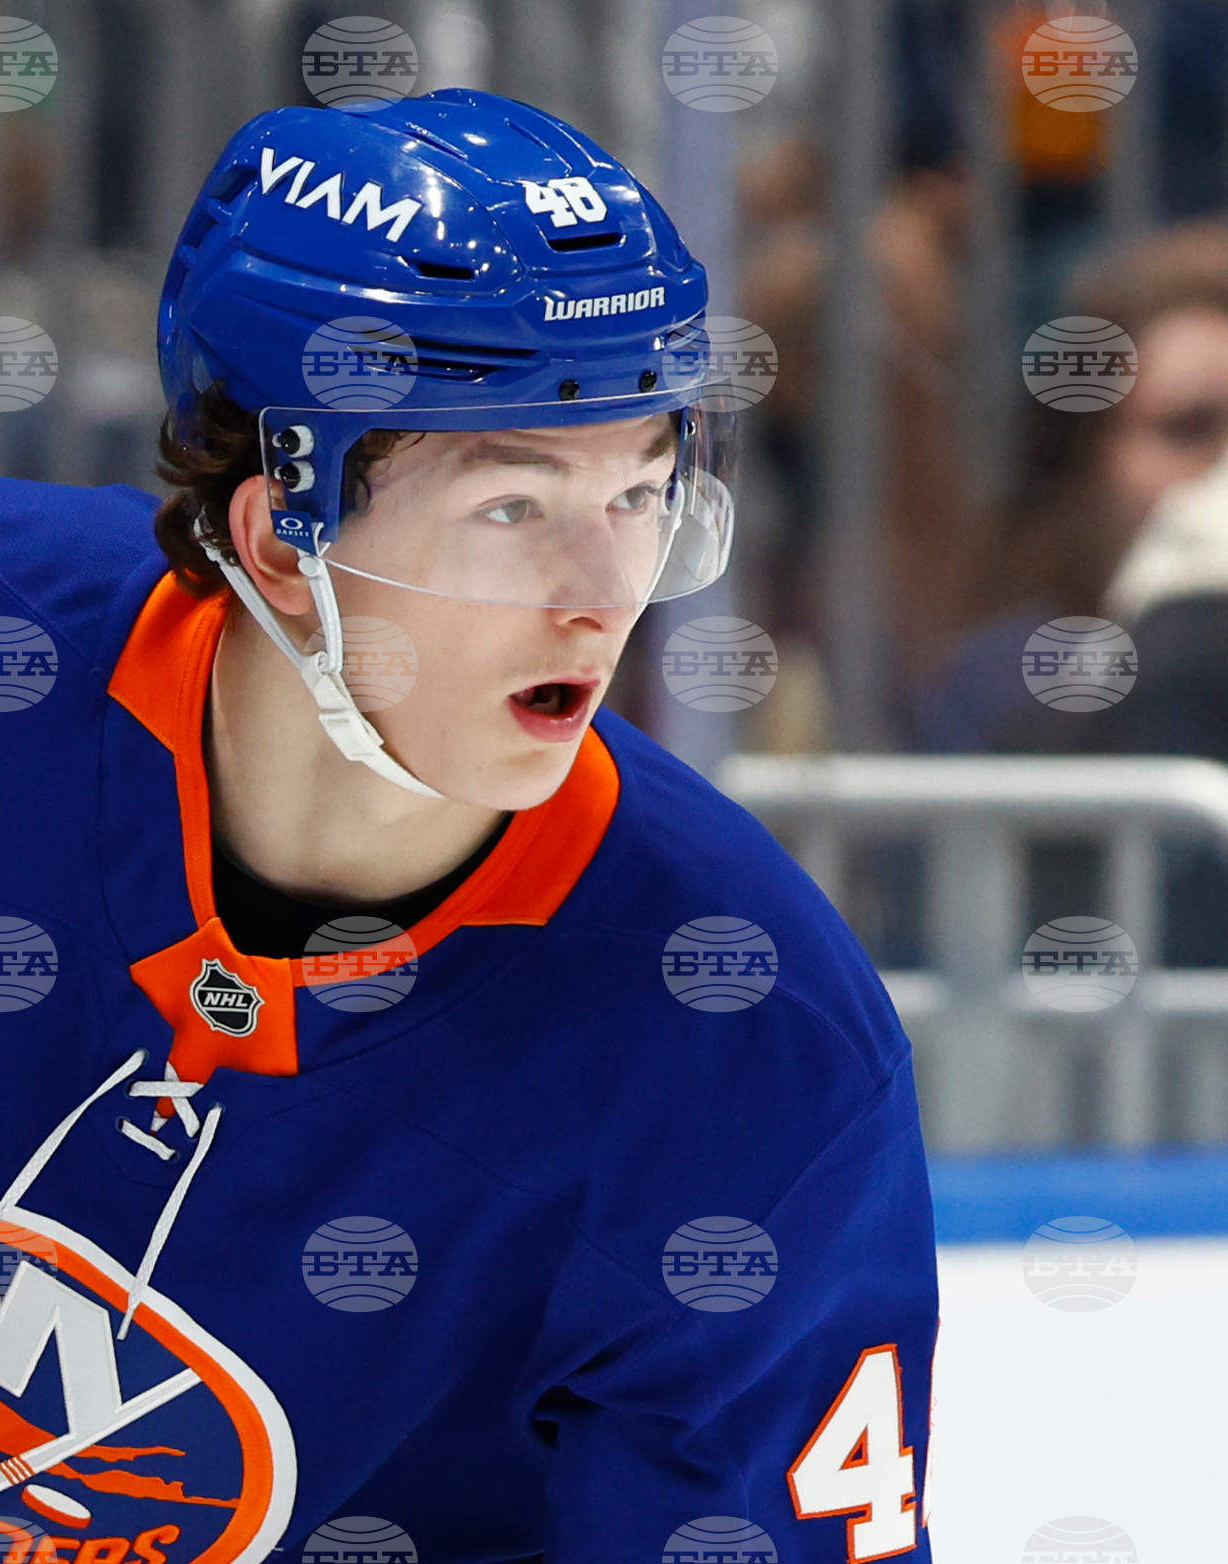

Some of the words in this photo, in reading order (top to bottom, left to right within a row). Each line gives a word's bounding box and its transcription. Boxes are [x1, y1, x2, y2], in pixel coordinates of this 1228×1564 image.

[258, 148, 422, 242] VIAM
[524, 176, 608, 228] 48
[544, 286, 665, 322] WARRIOR
[203, 991, 248, 1008] NHL
